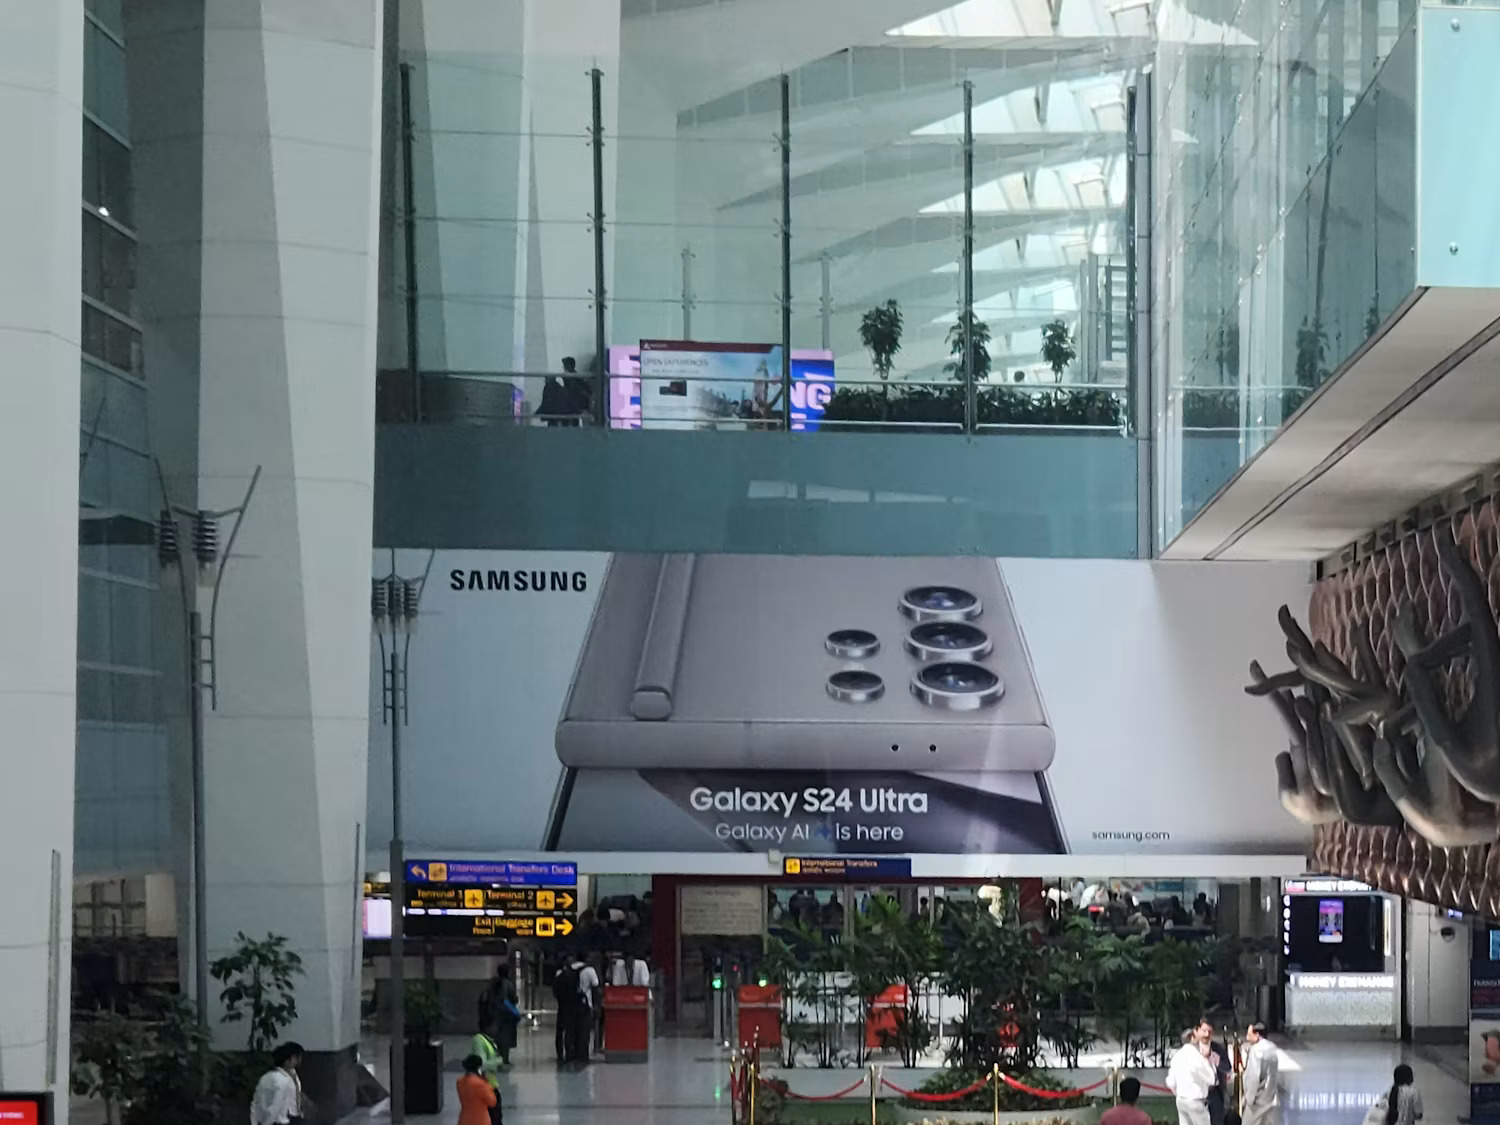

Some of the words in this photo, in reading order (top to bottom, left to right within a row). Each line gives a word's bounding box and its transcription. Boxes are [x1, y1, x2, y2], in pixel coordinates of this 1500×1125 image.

[450, 569, 587, 592] SAMSUNG
[690, 787, 798, 818] Galaxy
[803, 788, 853, 813] S24
[860, 788, 928, 813] Ultra
[715, 823, 787, 843] Galaxy
[791, 824, 810, 841] AI
[835, 823, 850, 841] is
[856, 823, 904, 841] here
[1091, 831, 1170, 843] samsung.com
[449, 864, 506, 873] International
[508, 864, 549, 874] Transfers
[552, 865, 575, 875] Desk
[417, 889, 455, 898] Terminal
[487, 891, 525, 899] Terminal
[475, 917, 492, 926] Exit
[495, 918, 534, 928] Baggage
[1299, 975, 1337, 988] MONEY
